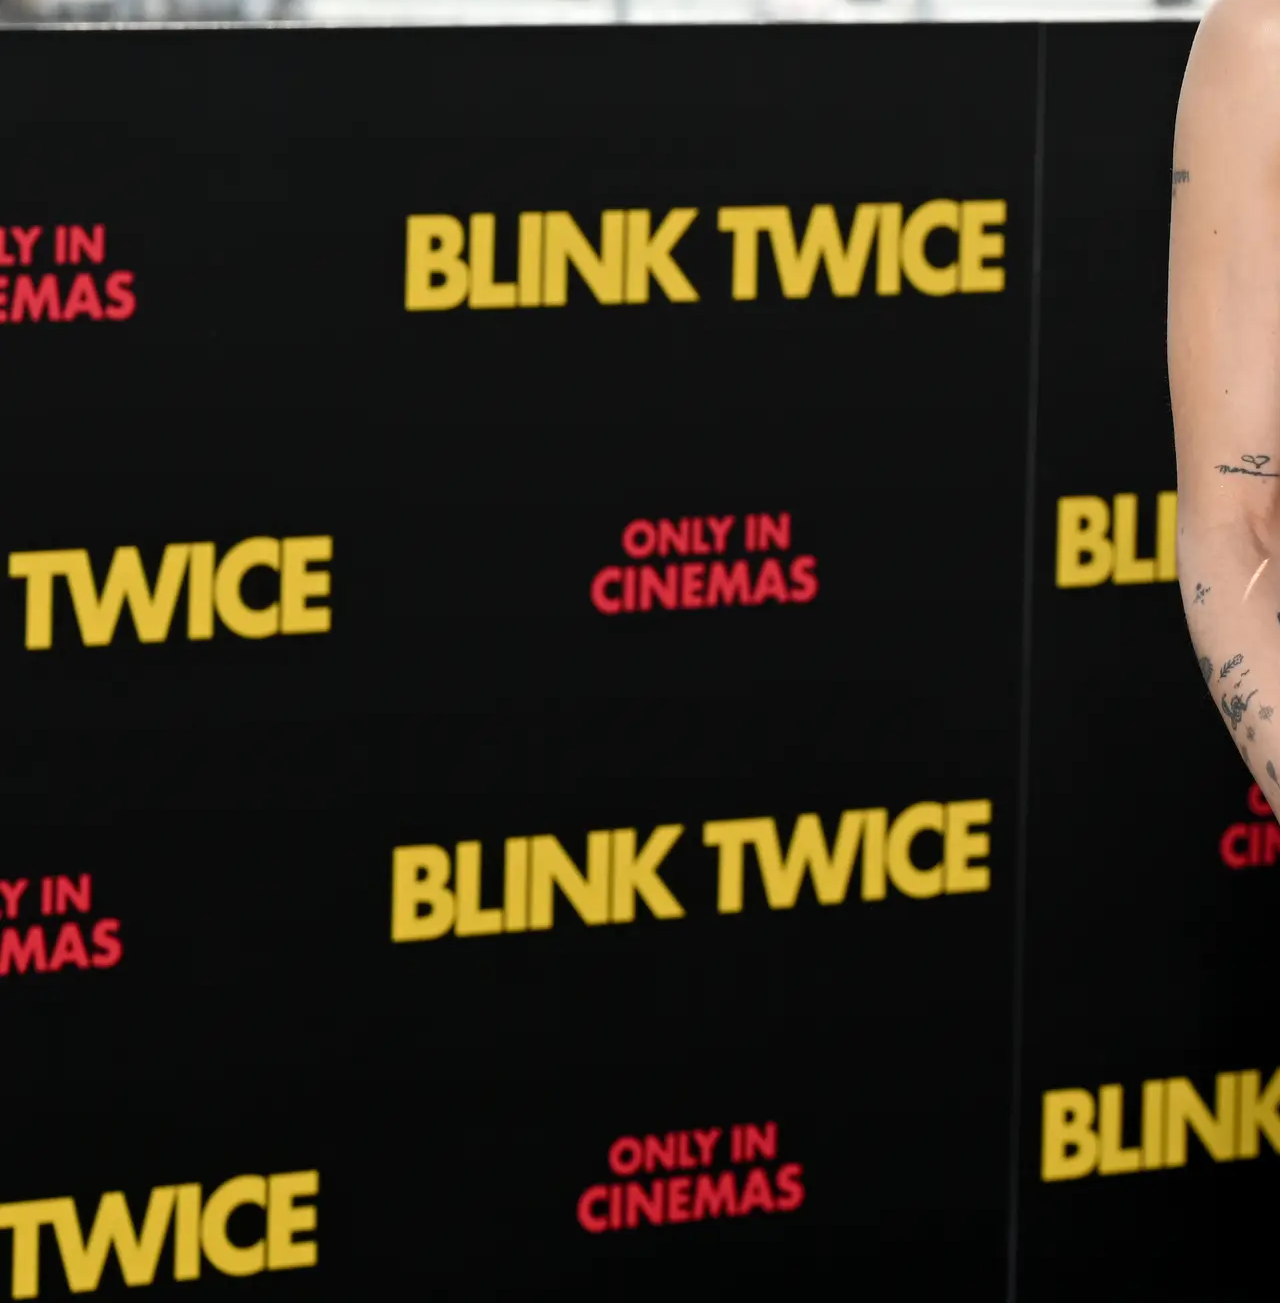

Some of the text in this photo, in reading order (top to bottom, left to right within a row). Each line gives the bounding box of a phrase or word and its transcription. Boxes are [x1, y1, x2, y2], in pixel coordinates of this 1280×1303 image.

[54, 223, 106, 266] IN
[404, 198, 1007, 312] BLINK TWICE
[621, 511, 792, 560] ONLY IN
[8, 535, 333, 651] TWICE
[590, 554, 820, 615] CINEMAS
[40, 872, 93, 917] IN
[391, 799, 992, 943] BLINK TWICE
[608, 1121, 779, 1177] ONLY IN
[577, 1162, 805, 1233] CINEMAS
[0, 1169, 320, 1301] TWICE
